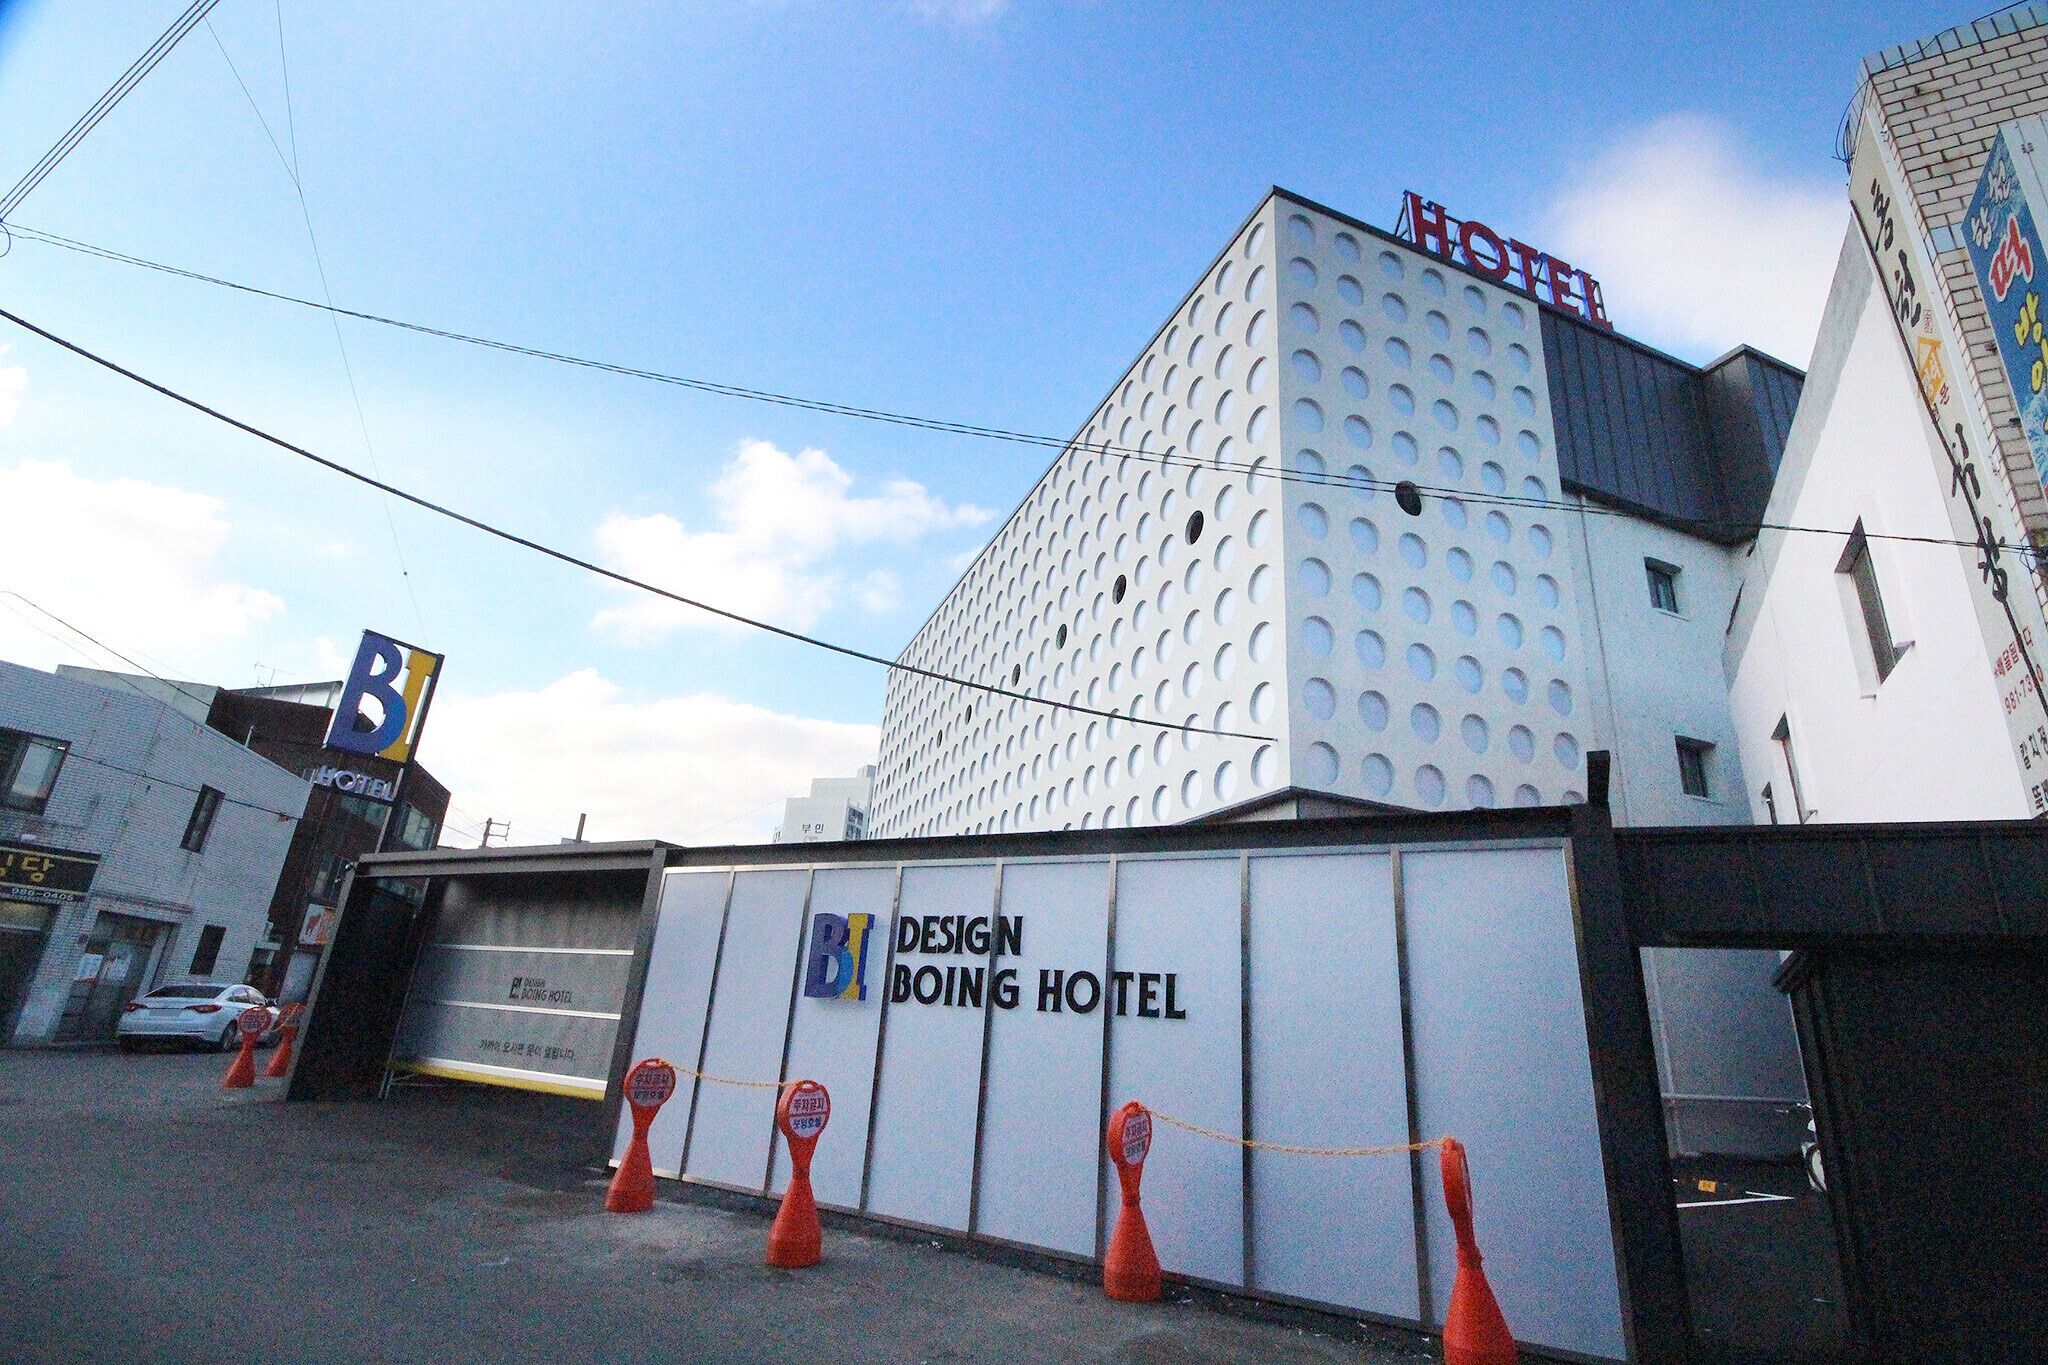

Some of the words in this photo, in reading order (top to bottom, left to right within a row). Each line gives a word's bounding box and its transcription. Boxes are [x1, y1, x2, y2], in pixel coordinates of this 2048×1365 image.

[1403, 190, 1613, 332] HOTEL
[324, 630, 438, 764] BI
[314, 763, 395, 800] HOTEL
[804, 912, 875, 1001] BI
[896, 915, 1024, 956] DESIGN
[520, 988, 548, 1001] BOING
[548, 990, 572, 1003] HOTEL
[890, 963, 1020, 1010] BOING
[1037, 968, 1187, 1020] HOTEL
[793, 1098, 825, 1111] 주차금지
